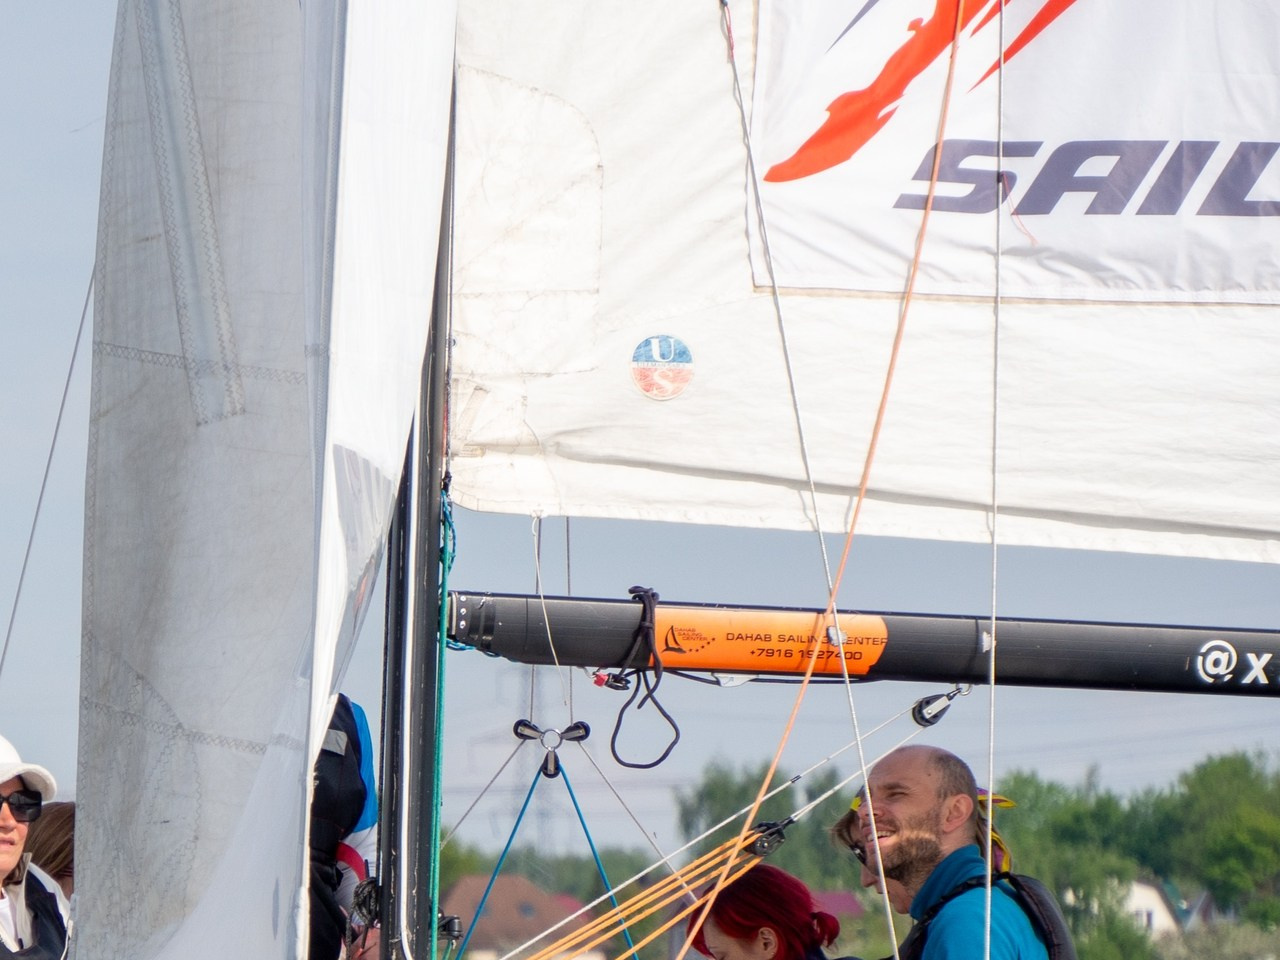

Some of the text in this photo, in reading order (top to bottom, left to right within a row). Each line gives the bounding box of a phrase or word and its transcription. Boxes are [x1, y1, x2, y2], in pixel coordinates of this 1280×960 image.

[726, 632, 772, 642] DAHAB
[839, 636, 888, 646] ENTER
[750, 648, 793, 658] +7916
